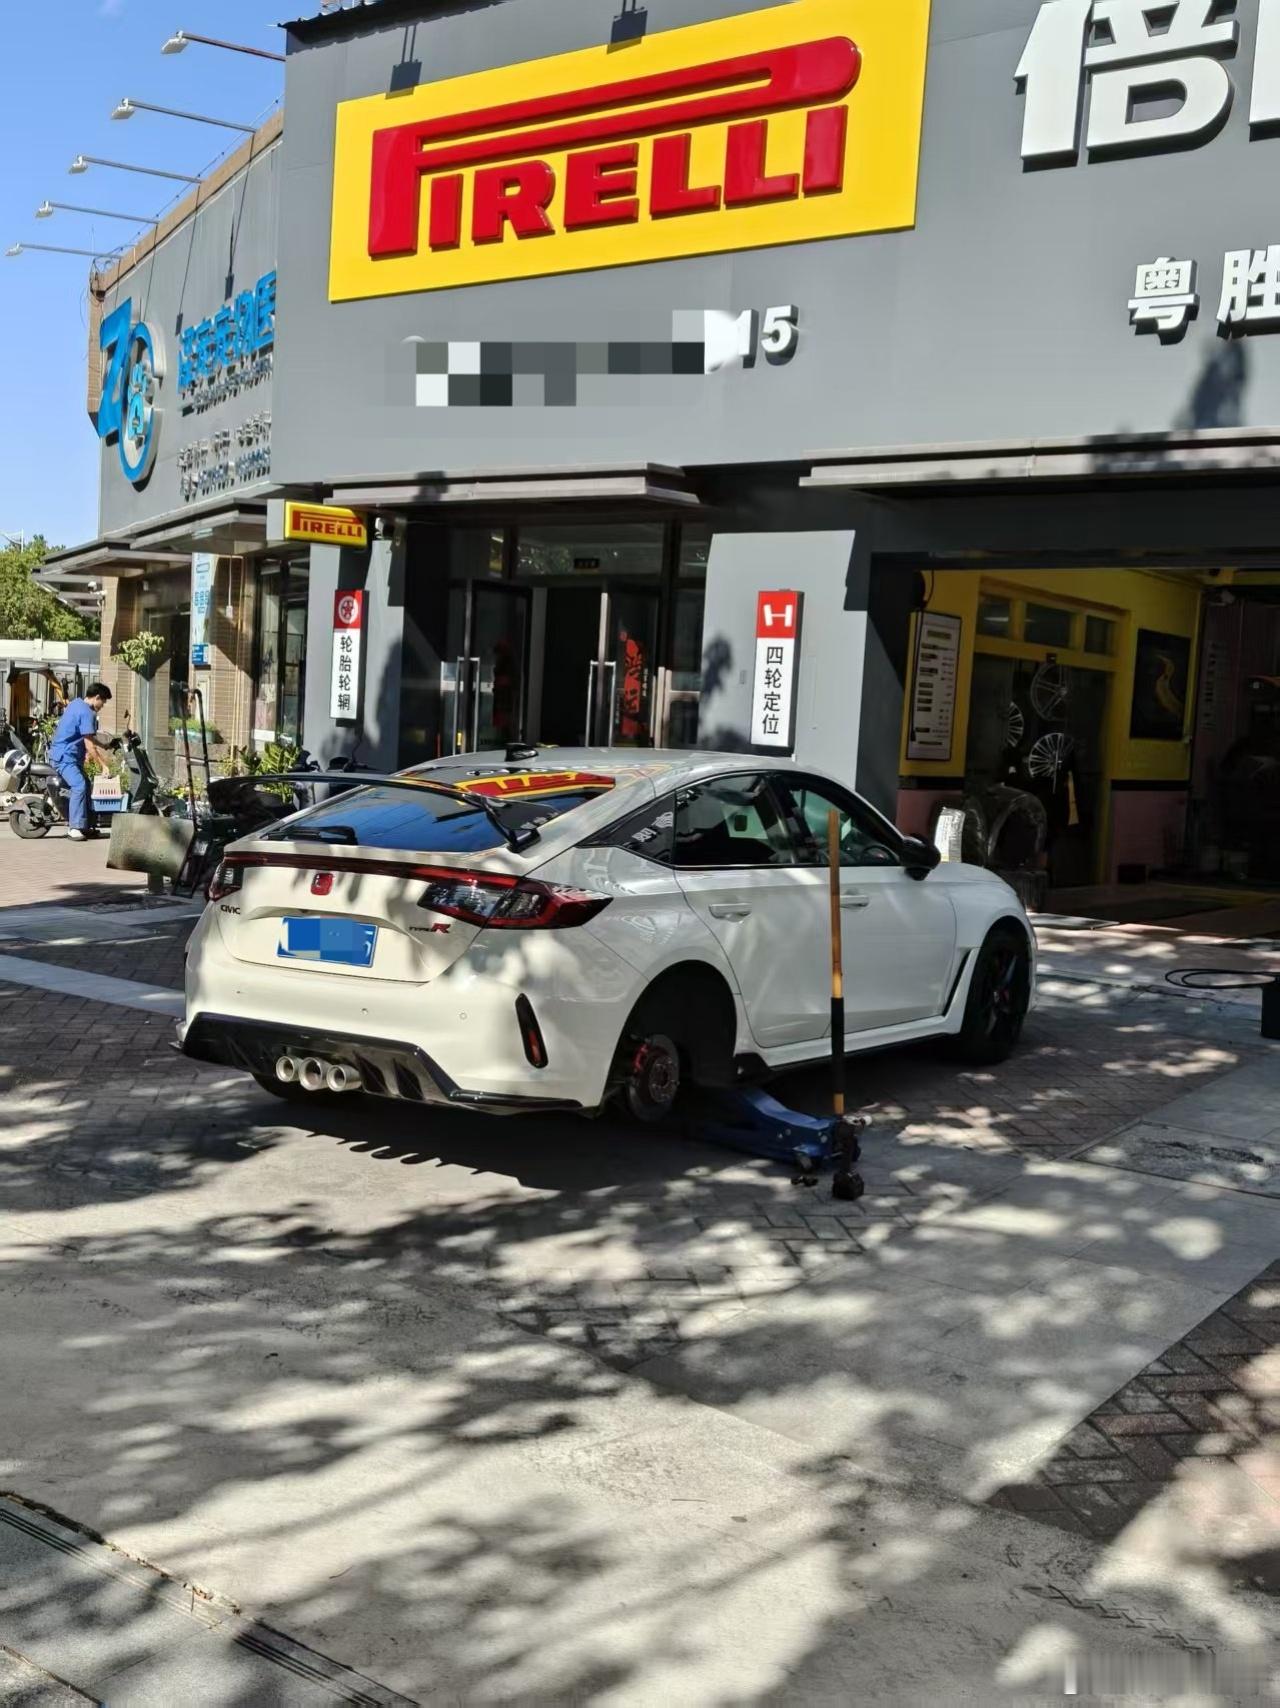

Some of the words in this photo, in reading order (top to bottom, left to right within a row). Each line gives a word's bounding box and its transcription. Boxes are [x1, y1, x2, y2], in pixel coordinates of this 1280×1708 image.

[1013, 0, 1280, 166] 倍
[368, 36, 862, 259] PIRELLI
[292, 509, 364, 538] PIRELLI
[337, 635, 353, 711] 轮胎轮辋
[762, 646, 784, 735] 四轮定位
[220, 904, 241, 915] CIVIC
